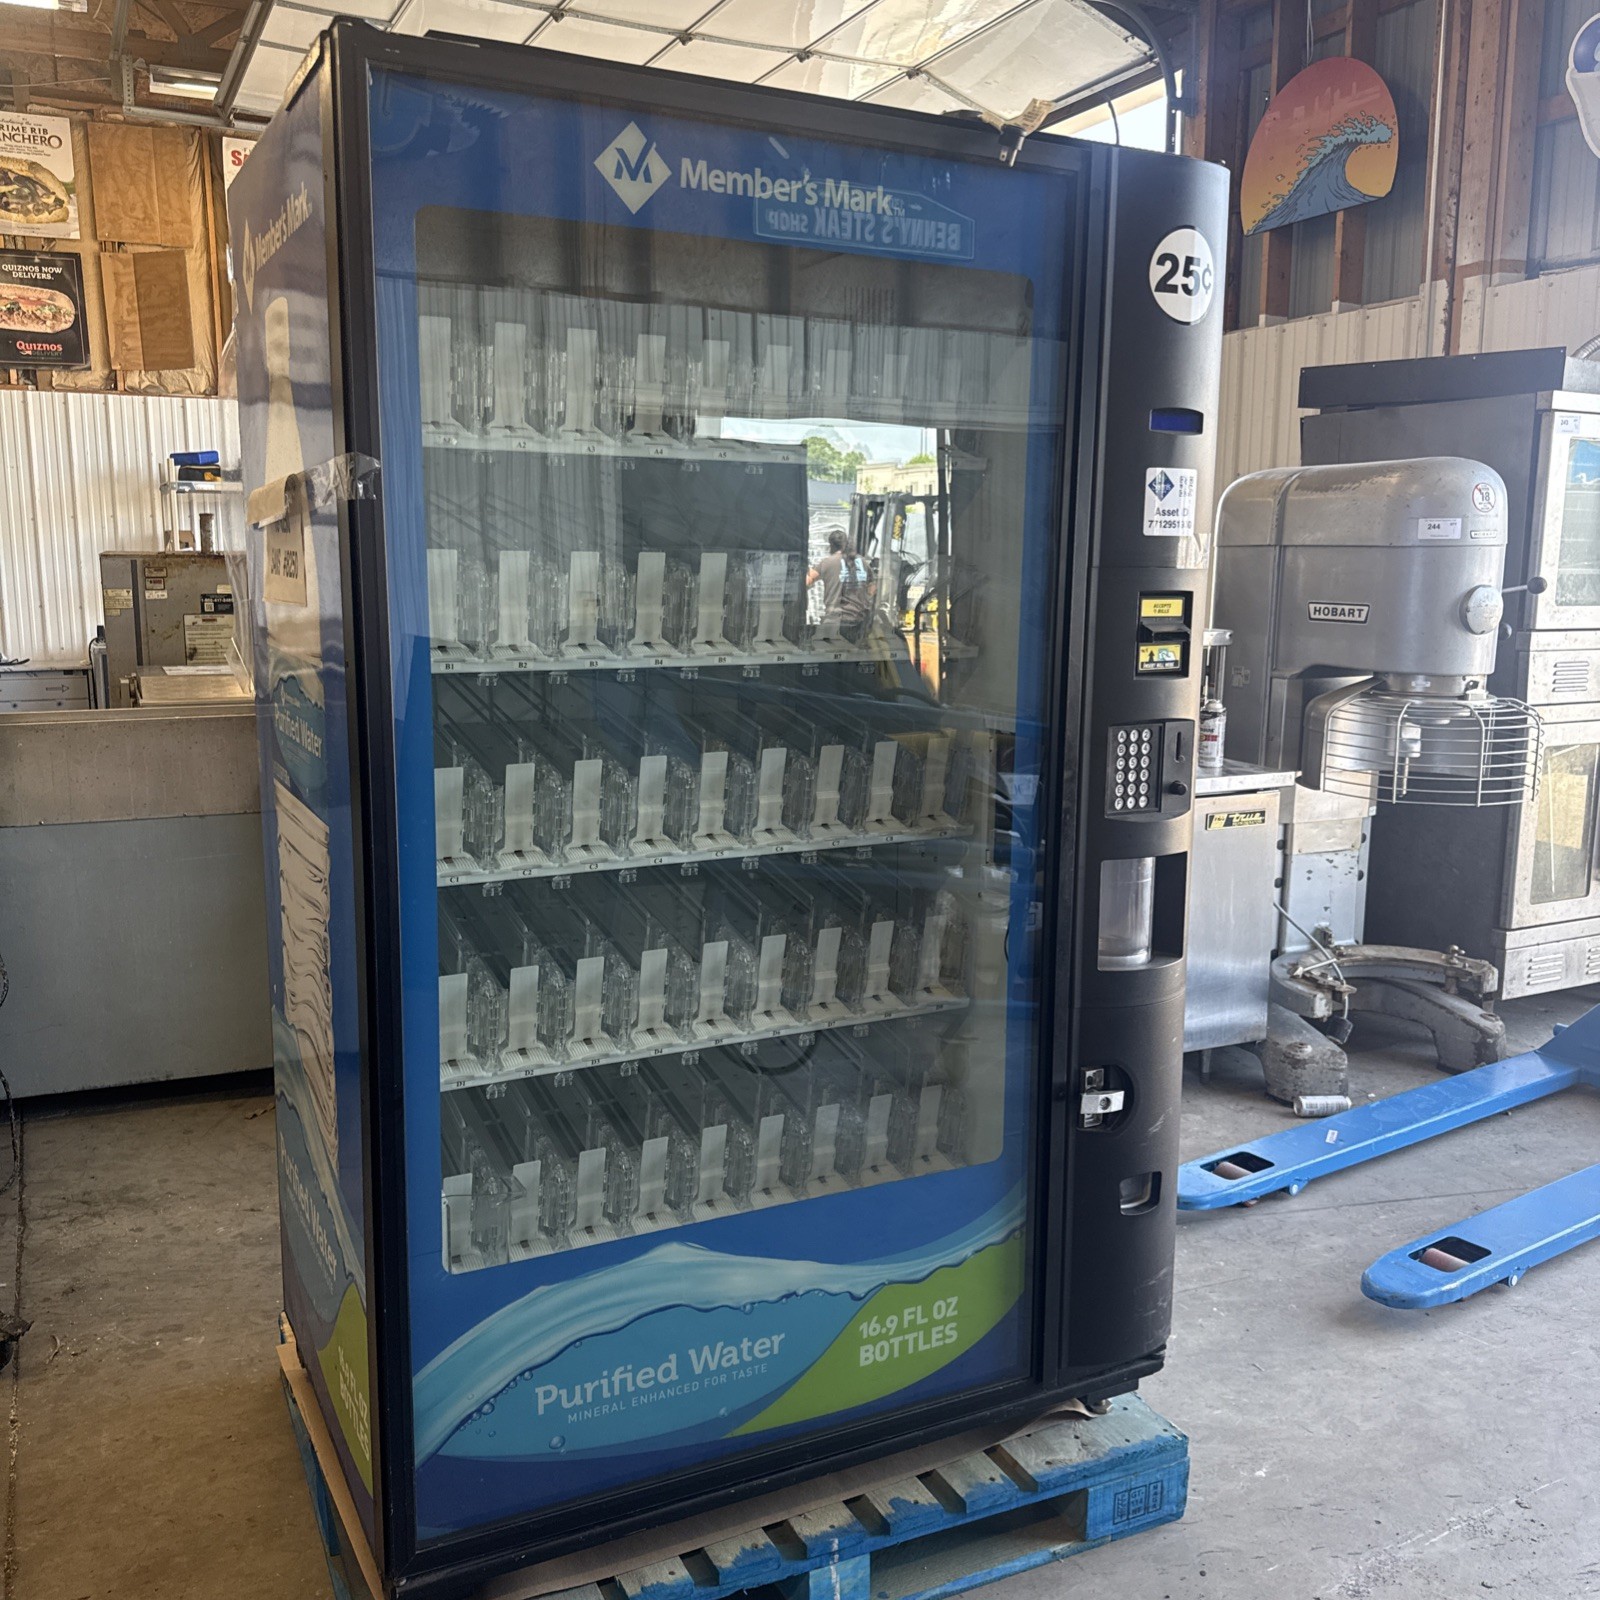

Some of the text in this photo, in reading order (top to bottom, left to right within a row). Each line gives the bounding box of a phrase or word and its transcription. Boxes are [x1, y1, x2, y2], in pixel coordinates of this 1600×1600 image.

[30, 127, 48, 135] RIB
[0, 132, 63, 149] NCHERO
[680, 157, 817, 206] Member's
[824, 178, 894, 216] Mark
[2, 264, 63, 274] QUIZNOS NOW
[12, 272, 54, 280] DELIVERS.
[16, 340, 63, 352] Quiznos
[1155, 507, 1179, 516] Asset
[1312, 606, 1366, 619] HOBART
[859, 1296, 959, 1339] 16.9 FL OZ
[859, 1322, 958, 1368] BOTTLES
[535, 1333, 786, 1416] Purified Water
[567, 1363, 768, 1424] MINERAL ENHANCED FOR TASTE
